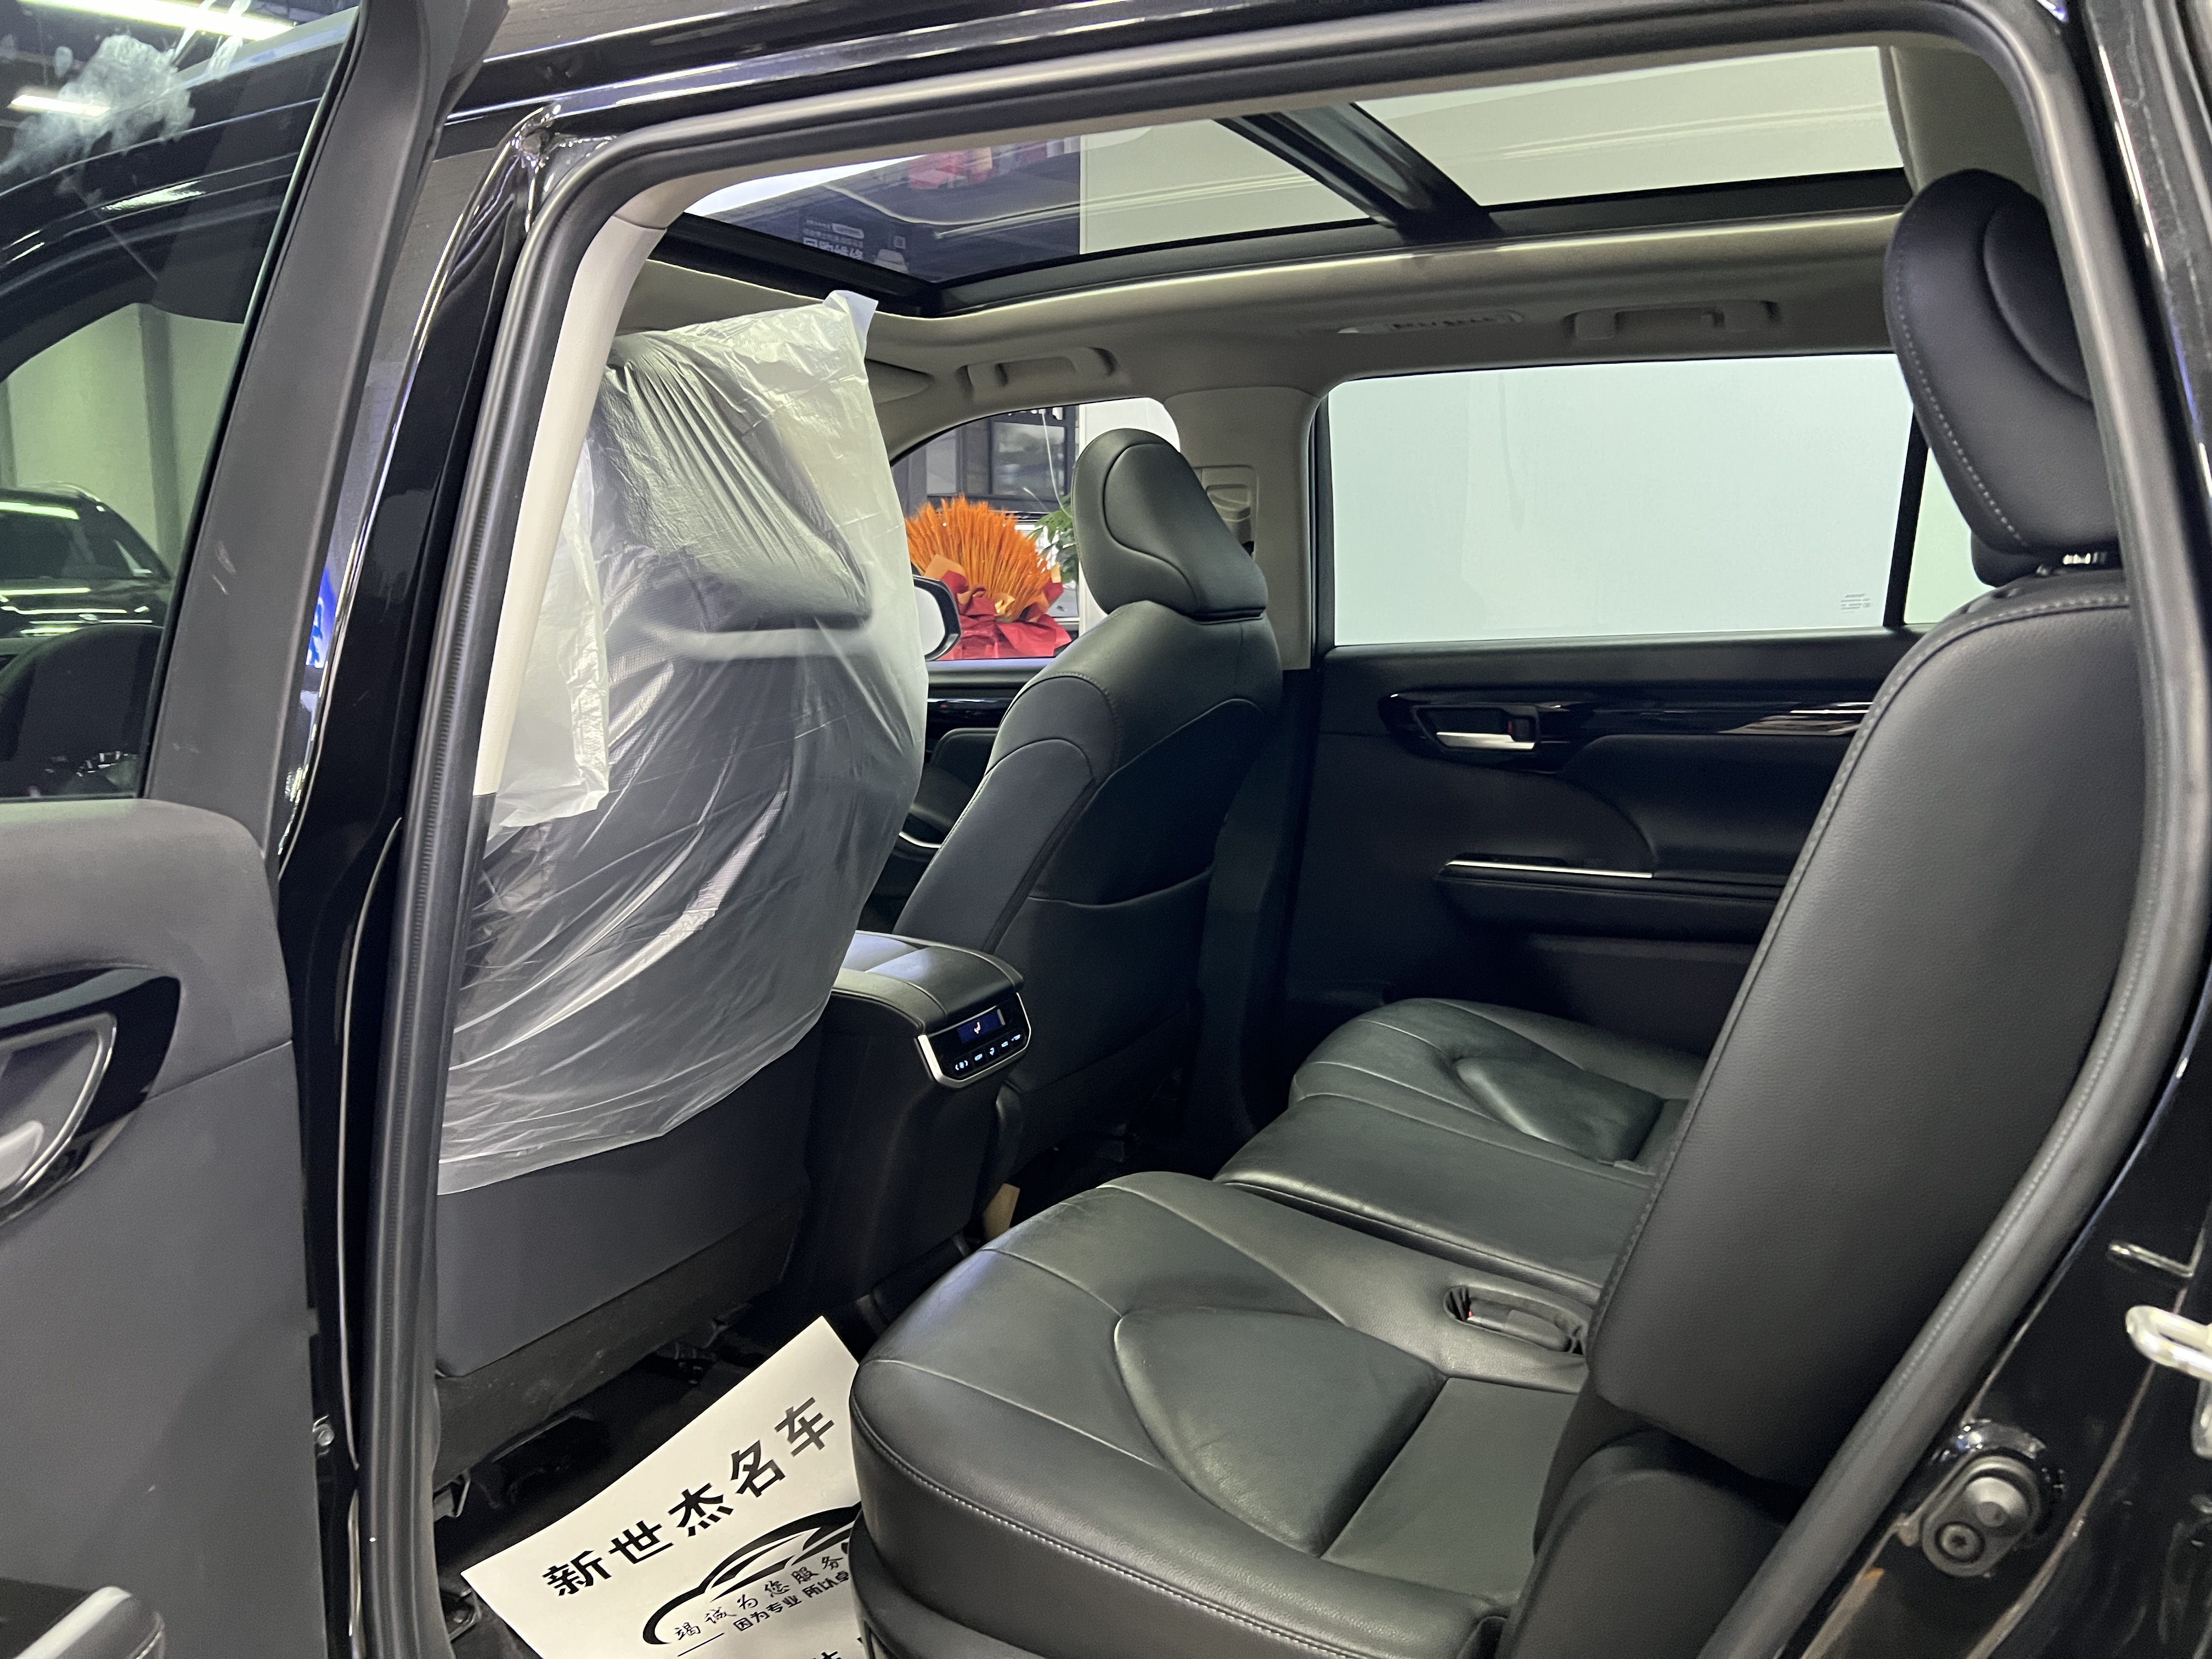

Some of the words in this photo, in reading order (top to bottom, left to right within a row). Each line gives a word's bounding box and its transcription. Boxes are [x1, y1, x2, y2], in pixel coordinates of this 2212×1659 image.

[542, 1397, 835, 1597] 新世杰名车
[674, 1556, 844, 1640] 竭诚为您服务
[733, 1595, 802, 1632] 因为专业
